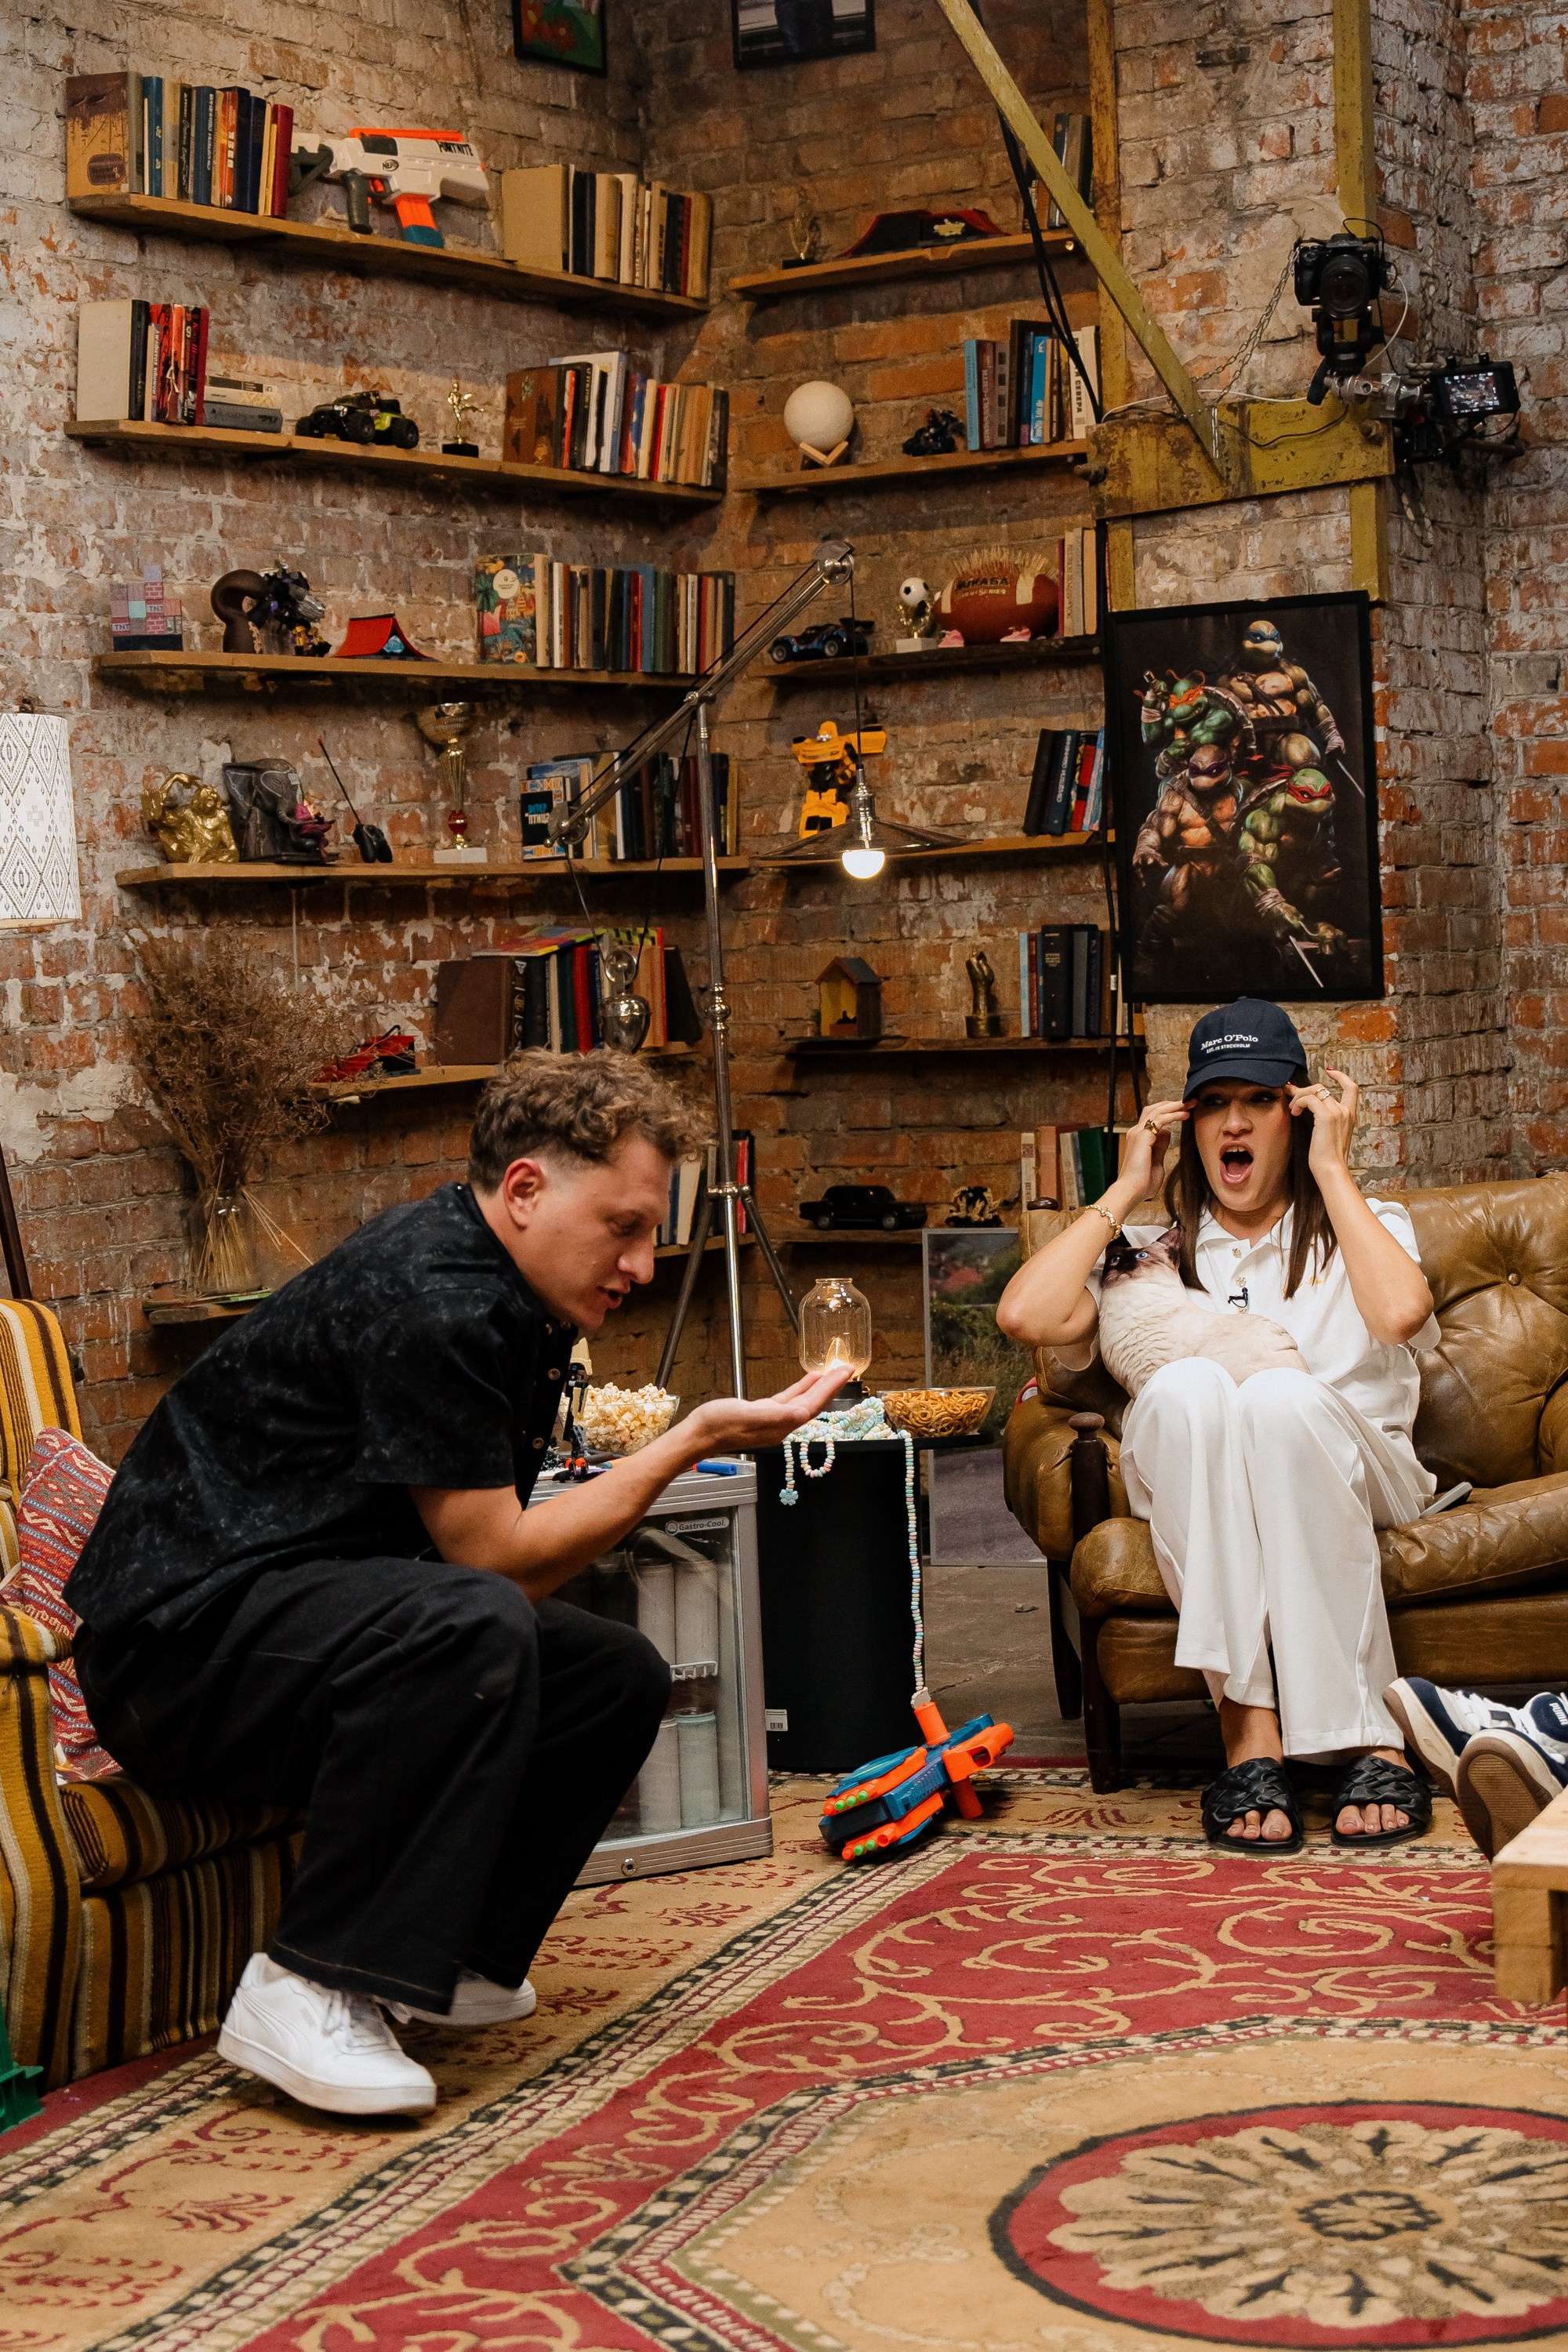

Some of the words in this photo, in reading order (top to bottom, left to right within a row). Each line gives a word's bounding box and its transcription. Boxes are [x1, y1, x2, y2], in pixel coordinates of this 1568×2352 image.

[437, 140, 474, 157] FORTNITE
[956, 577, 1008, 590] MIKASA
[1200, 1037, 1223, 1051] Marc
[1224, 1034, 1259, 1043] O'Polo
[679, 1519, 724, 1531] Gastro-Cool
[1548, 1702, 1568, 1726] PUMA
